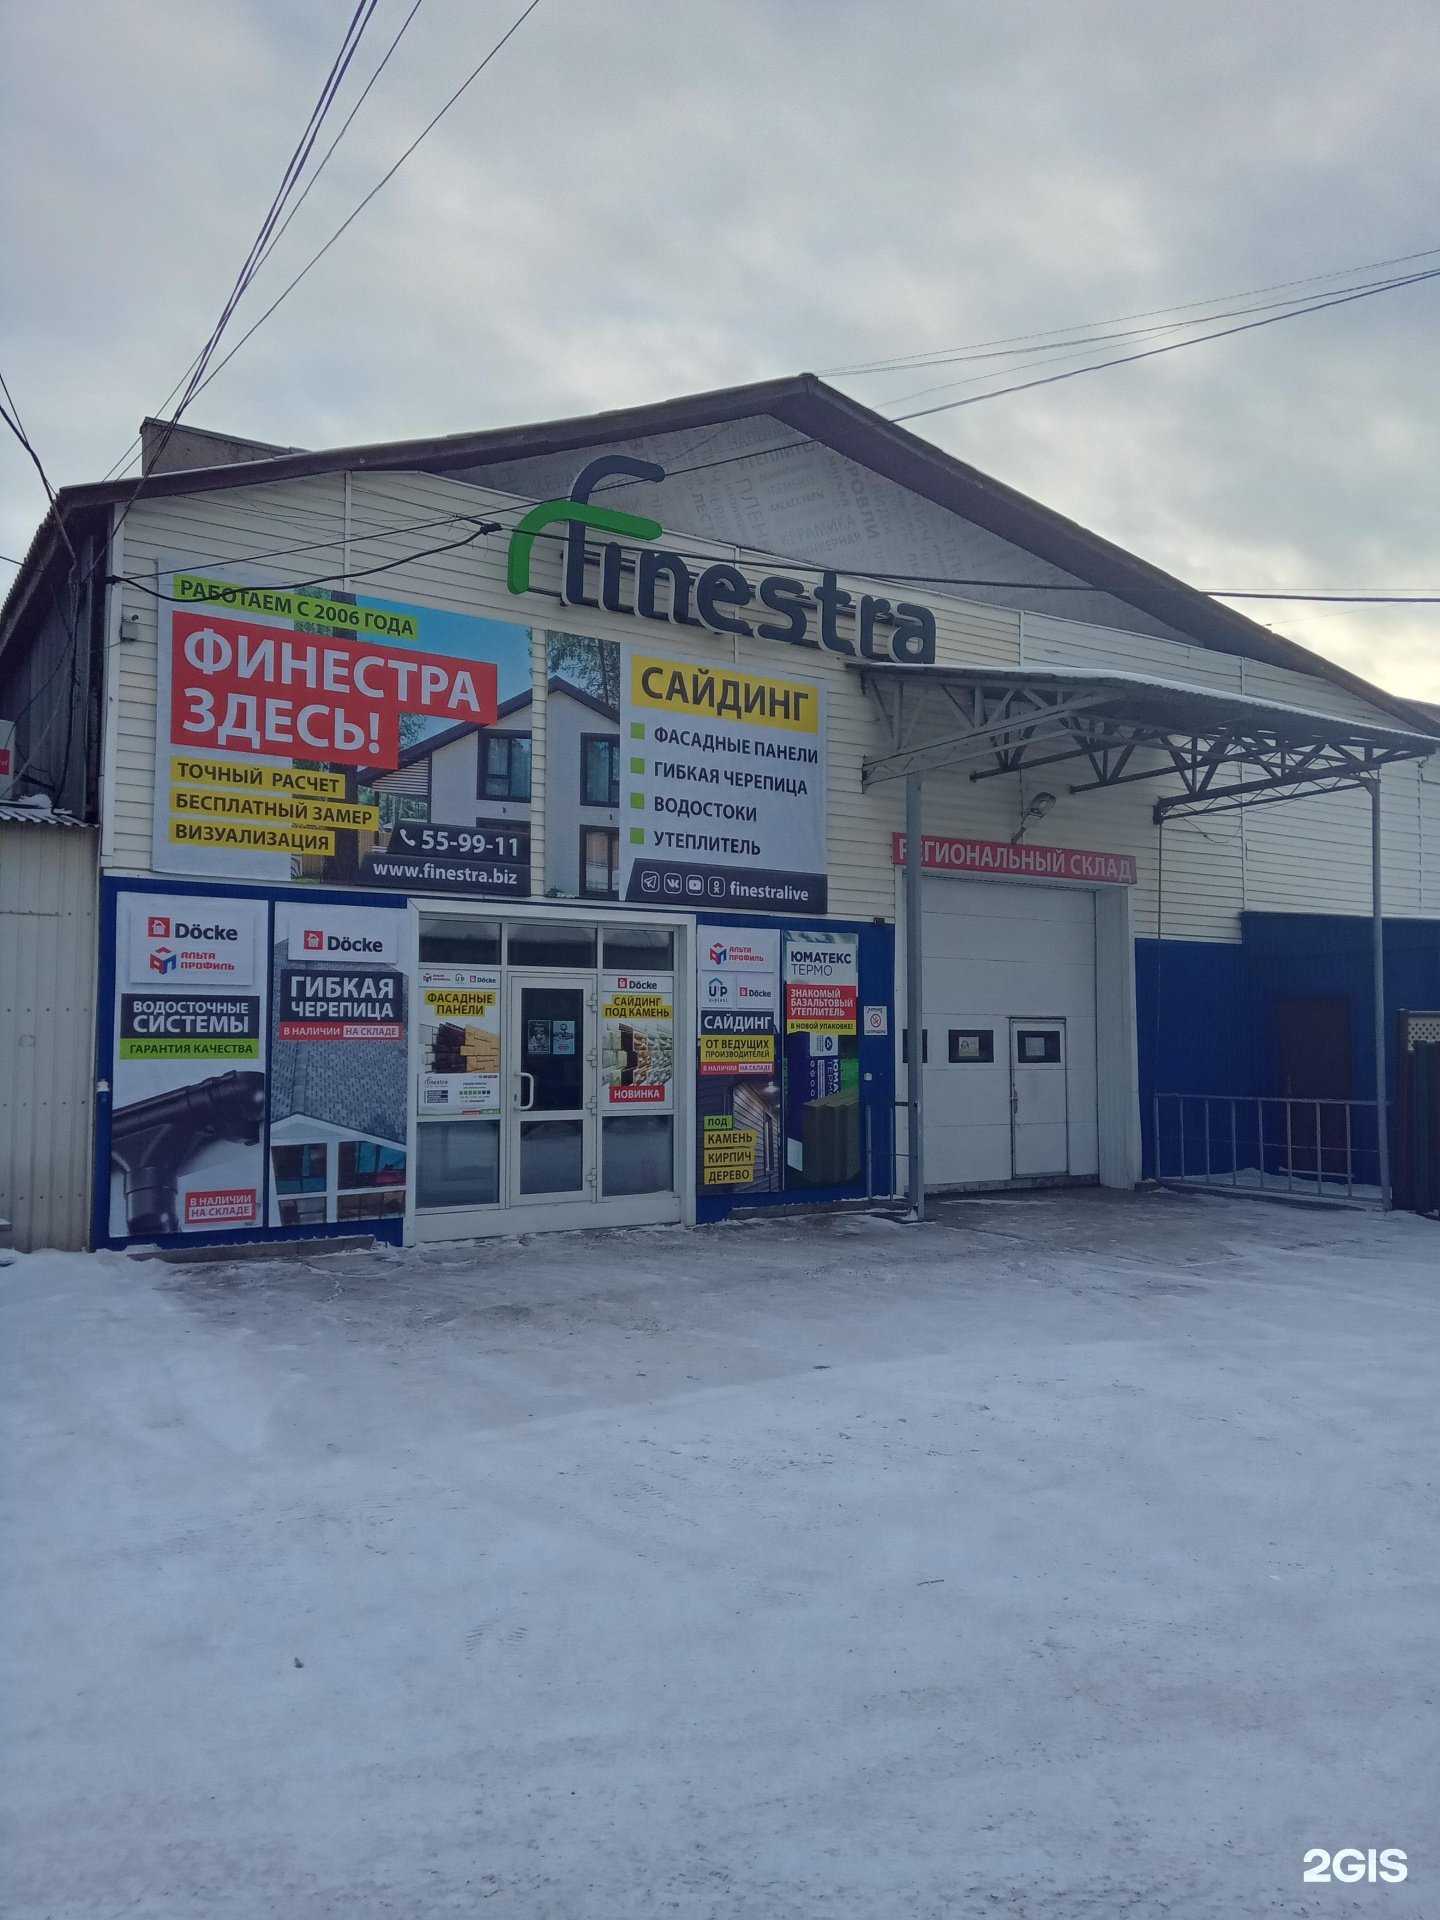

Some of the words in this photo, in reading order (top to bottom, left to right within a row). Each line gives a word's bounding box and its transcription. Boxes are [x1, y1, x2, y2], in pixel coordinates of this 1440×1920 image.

[507, 455, 936, 663] finestra
[180, 578, 292, 615] РАБОТАЕМ
[297, 601, 308, 617] С
[314, 604, 359, 625] 2006
[364, 613, 414, 637] ГОДА
[184, 628, 481, 712] ФИНЕСТРА
[641, 666, 808, 721] САЙДИНГ
[182, 688, 379, 754] ЗДЕСЬ!
[654, 727, 750, 755] ФАСАДНЫЕ
[754, 742, 818, 764] ПАНЕЛИ
[177, 762, 263, 786] ТОЧНЫЙ
[272, 772, 340, 794] РАСЧЕТ
[654, 761, 720, 784] ГИБКАЯ
[723, 771, 808, 797] ЧЕРЕПИЦА
[175, 793, 308, 820] БЕСПЛАТНЫЙ
[312, 807, 373, 826] ЗАМЕР
[654, 796, 757, 822] ВОДОСТОКИ
[175, 824, 330, 852] ВИЗУАЛИЗАЦИЯ
[421, 830, 518, 857] 55-99-11
[654, 831, 761, 855] УТЕПЛИТЕЛЬ
[373, 861, 518, 885] www.finestra.biz
[1070, 854, 1132, 882] СКЛАД
[729, 881, 809, 901] finestralive
[174, 922, 238, 941] Döcke
[327, 936, 383, 953] Döcke
[791, 951, 851, 964] ЮМАТЕКС
[180, 962, 235, 971] ПРОФИЛЬ
[792, 964, 832, 976] ТЕРМО
[290, 976, 394, 999] ГИБКАЯ
[629, 980, 657, 989] Döcke
[427, 992, 493, 1004] ФАСАДНЫЕ
[749, 989, 771, 997] Döcke
[790, 988, 840, 998] ЗНАКОМЫЙ
[133, 1001, 249, 1014] ВОДОСТОЧНЫЕ
[614, 996, 661, 1007] САЙДИНГ
[791, 998, 853, 1008] БАЗАЛЬТОВЫЙ
[290, 1002, 394, 1020] ЧЕРЕПИЦА
[437, 1005, 484, 1015] ПАНЕЛИ
[605, 1008, 627, 1018] ПОД
[629, 1008, 669, 1017] КАМЕНЬ
[791, 1008, 845, 1017] УТЕПЛИТЕЛЬ
[133, 1015, 249, 1034] СИСТЕМЫ
[704, 1014, 771, 1032] САЙДИНГ
[284, 1026, 290, 1036] В
[292, 1026, 340, 1036] НАЛИЧИИ
[346, 1027, 358, 1036] НА
[360, 1027, 398, 1038] СКЛАДЕ
[130, 1044, 192, 1054] ГАРАНТИЯ
[194, 1044, 253, 1055] КАЧЕСТВА
[706, 1040, 719, 1048] ОТ
[722, 1039, 769, 1051] ВЕДУЩИХ
[706, 1050, 769, 1059] ПРОИЗВОДИТЕЛЕЙ
[614, 1089, 660, 1099] НОВИНКА
[708, 1118, 727, 1127] ПОД
[708, 1133, 752, 1144] КАМЕНЬ
[708, 1152, 751, 1162] КИРПИЧ
[708, 1170, 749, 1183] ДЕРЕВО
[190, 1197, 196, 1206] В
[200, 1194, 252, 1206] НАЛИЧИИ
[190, 1208, 206, 1218] НА
[208, 1206, 250, 1216] СКЛАДЕ
